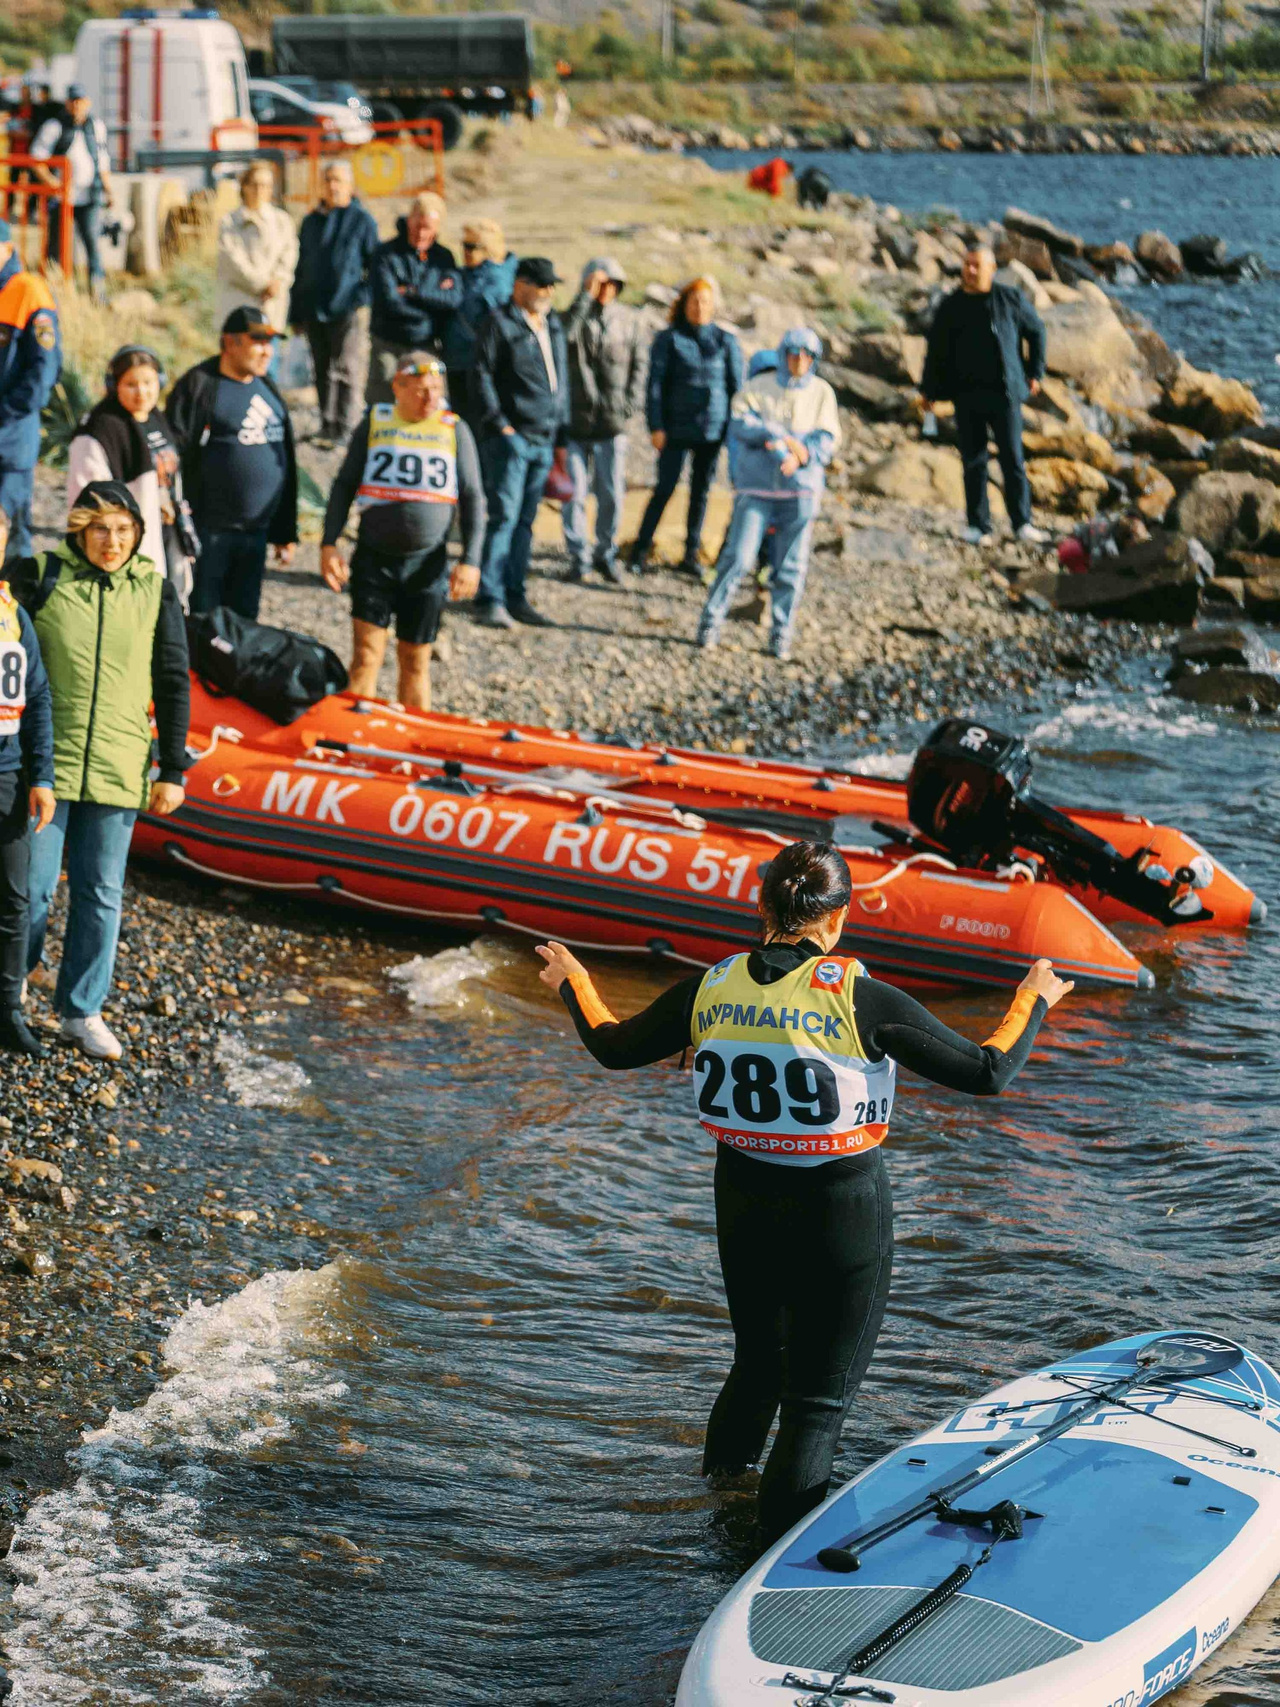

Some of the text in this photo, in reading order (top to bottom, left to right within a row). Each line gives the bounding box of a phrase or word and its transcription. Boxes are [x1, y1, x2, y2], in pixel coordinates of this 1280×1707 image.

[371, 451, 448, 489] 293
[389, 794, 531, 853] 0607
[543, 821, 673, 882] RUS
[697, 1003, 844, 1040] МУРМАНСК
[695, 1049, 842, 1127] 289
